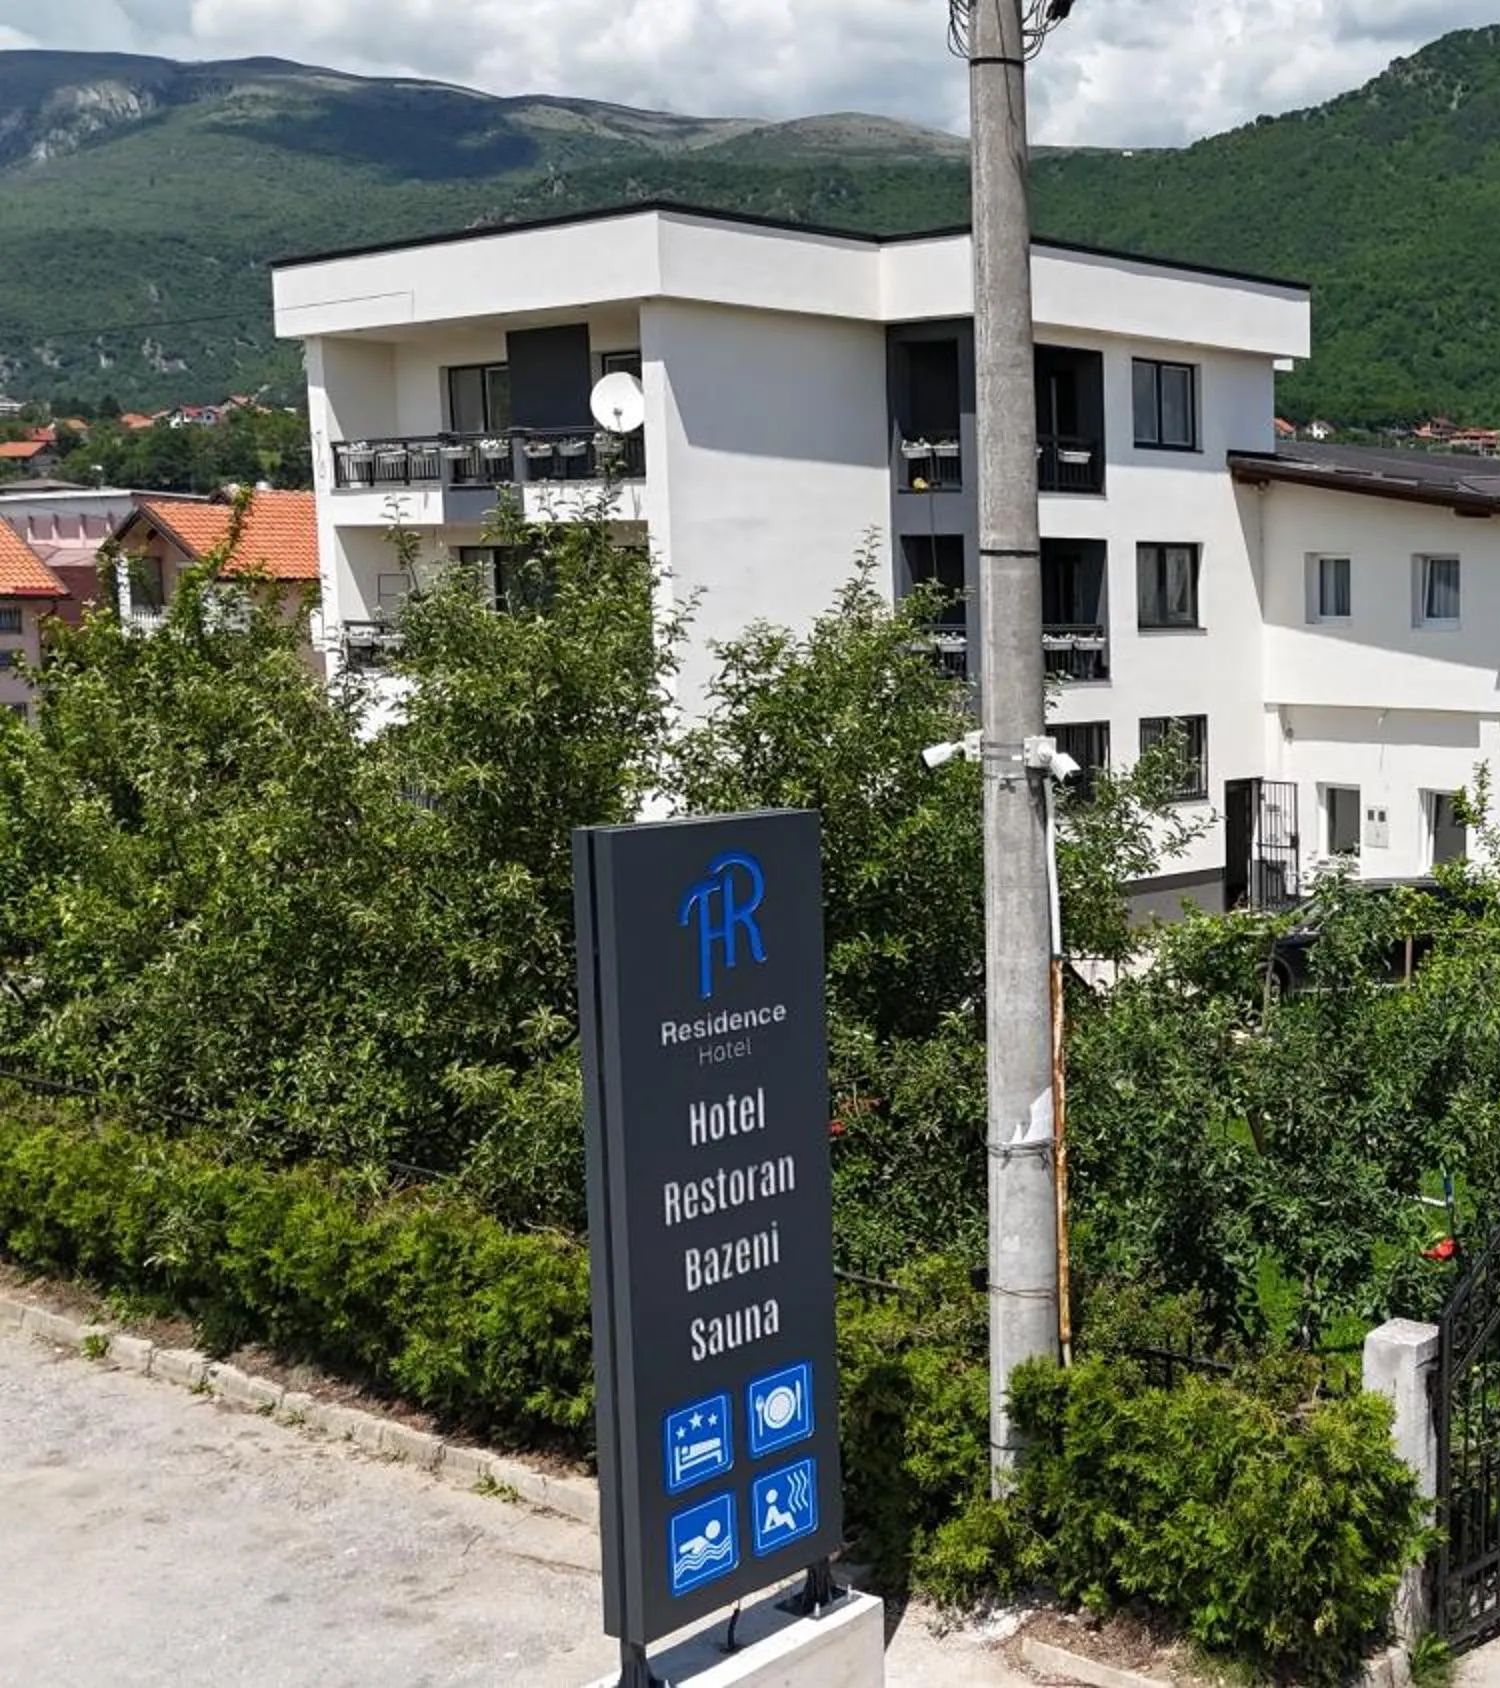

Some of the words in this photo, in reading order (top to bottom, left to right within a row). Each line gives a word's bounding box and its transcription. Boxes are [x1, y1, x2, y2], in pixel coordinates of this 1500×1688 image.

[660, 1003, 788, 1047] Residence
[698, 1037, 753, 1067] Hotel
[688, 1086, 766, 1147] Hotel
[663, 1154, 796, 1227] Restoran
[684, 1219, 780, 1293] Bazeni
[690, 1297, 780, 1362] Sauna
